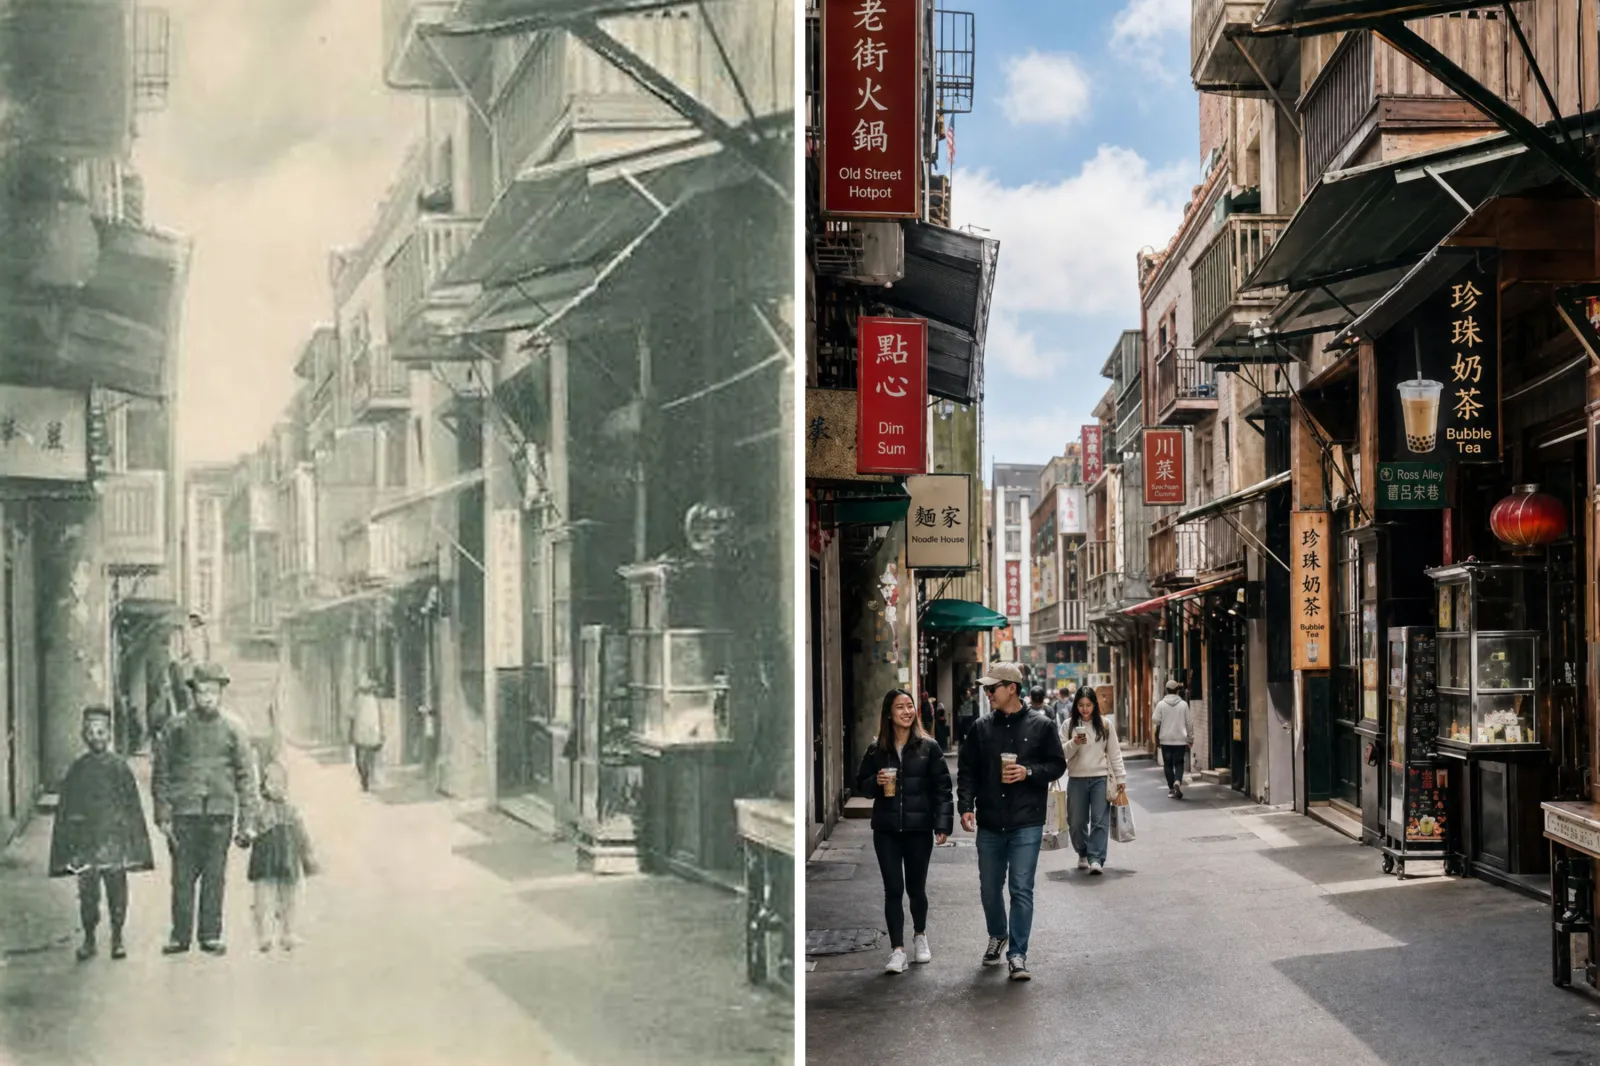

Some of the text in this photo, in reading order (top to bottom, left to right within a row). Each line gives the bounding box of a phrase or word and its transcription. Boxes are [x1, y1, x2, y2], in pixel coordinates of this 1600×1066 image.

[851, 0, 888, 153] 老街火鍋
[839, 168, 902, 181] Old Street
[849, 185, 892, 200] Hotpot
[1450, 280, 1484, 421] 珍珠奶茶
[875, 333, 909, 398] 點心
[878, 421, 904, 435] Dim
[1446, 427, 1492, 440] Bubble
[877, 441, 906, 455] Sum
[1456, 441, 1482, 454] Tea
[1154, 437, 1176, 481] 川菜
[1397, 469, 1444, 482] Ross Alley
[915, 505, 962, 529] 麵家
[911, 535, 965, 544] Noodle House
[1301, 528, 1322, 616] 珍珠奶茶
[1300, 623, 1325, 631] Bubble
